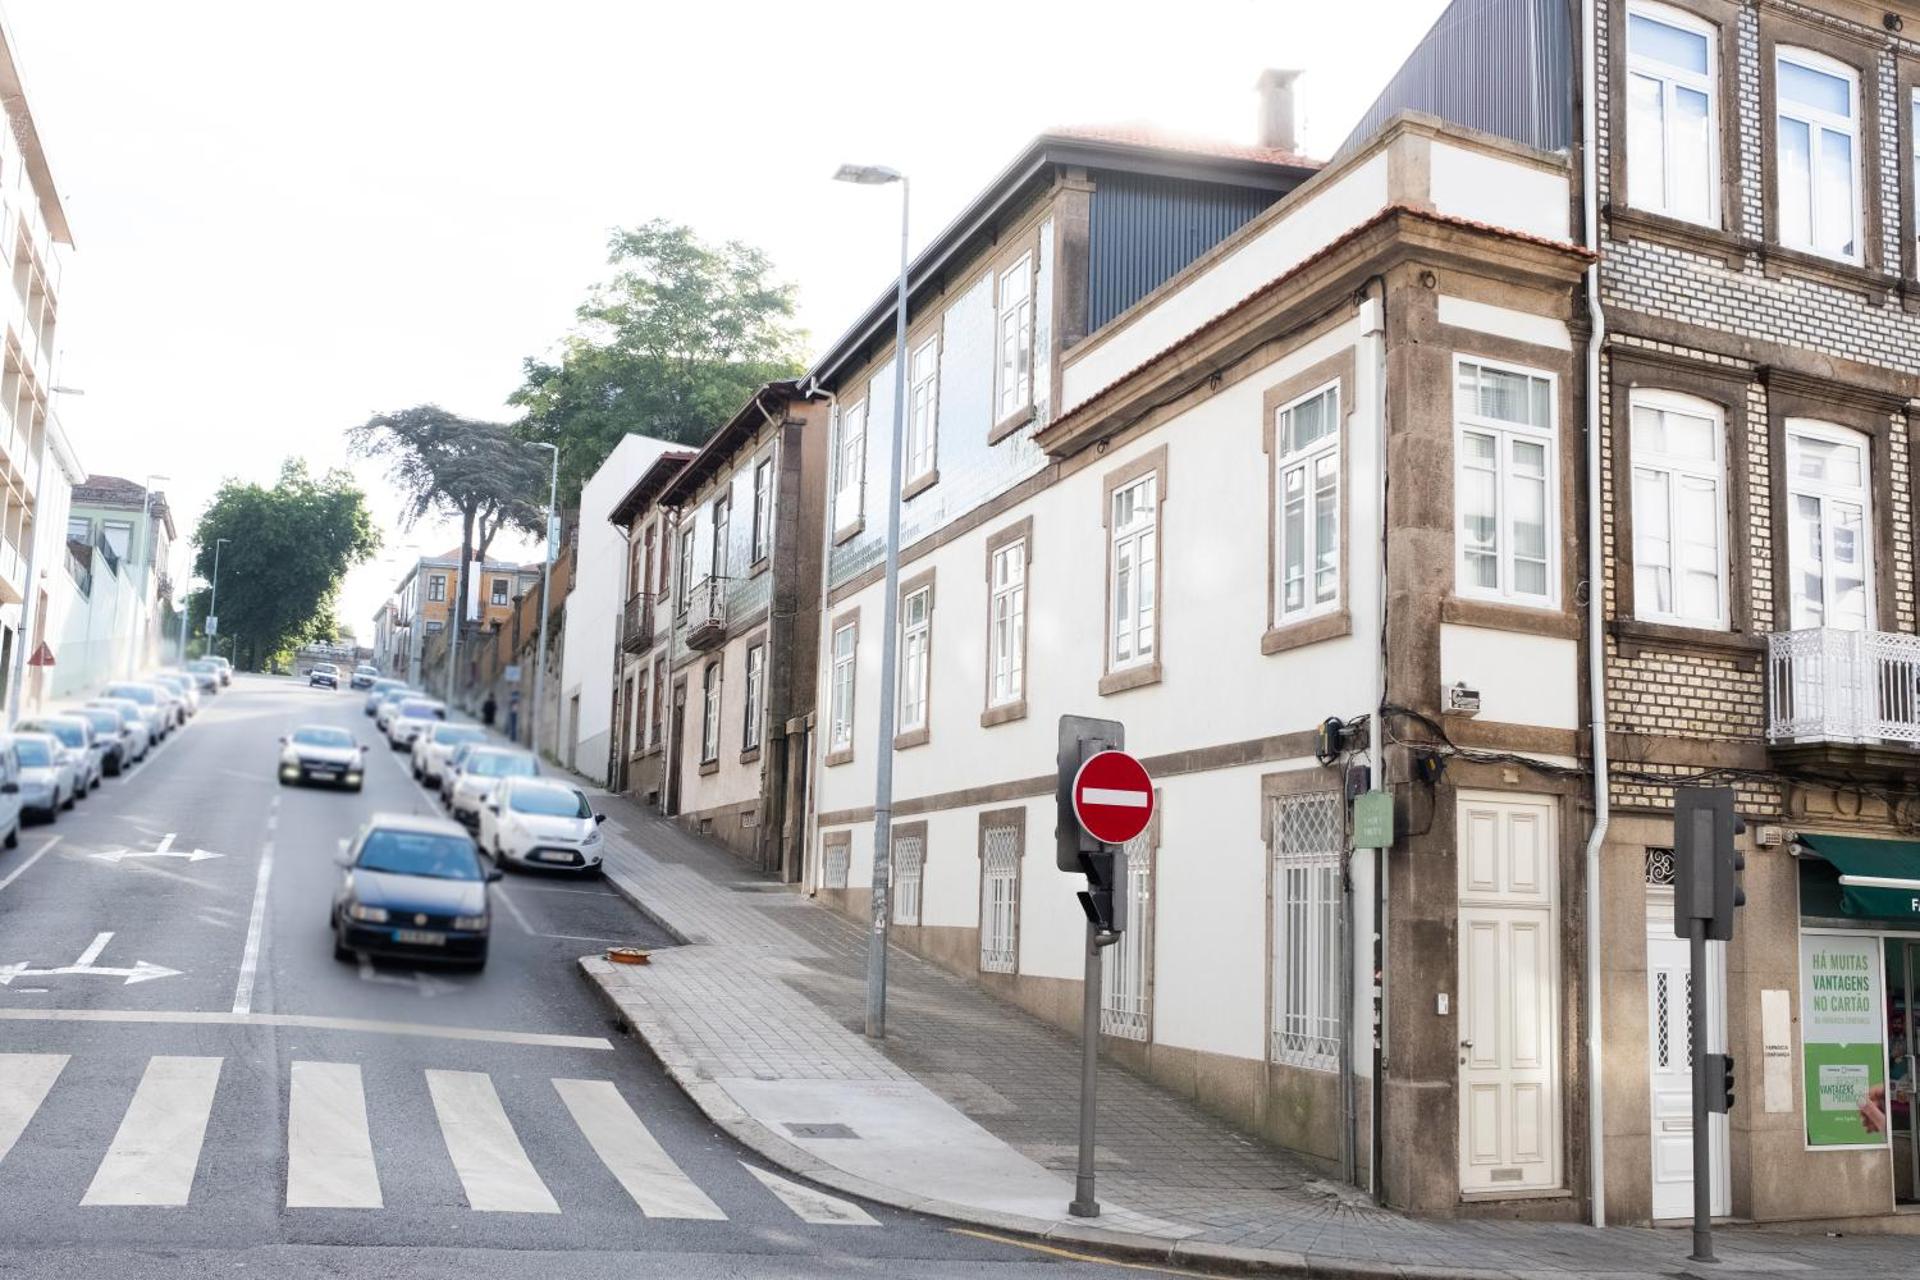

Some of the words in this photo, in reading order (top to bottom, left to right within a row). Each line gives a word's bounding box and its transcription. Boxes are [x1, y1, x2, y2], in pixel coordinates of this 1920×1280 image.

[1911, 898, 1920, 912] F
[1813, 949, 1827, 970] HÁ
[1830, 954, 1868, 971] MUITAS
[1813, 975, 1870, 992] VANTAGENS
[1814, 995, 1828, 1012] NO
[1831, 993, 1870, 1012] CARTÃO
